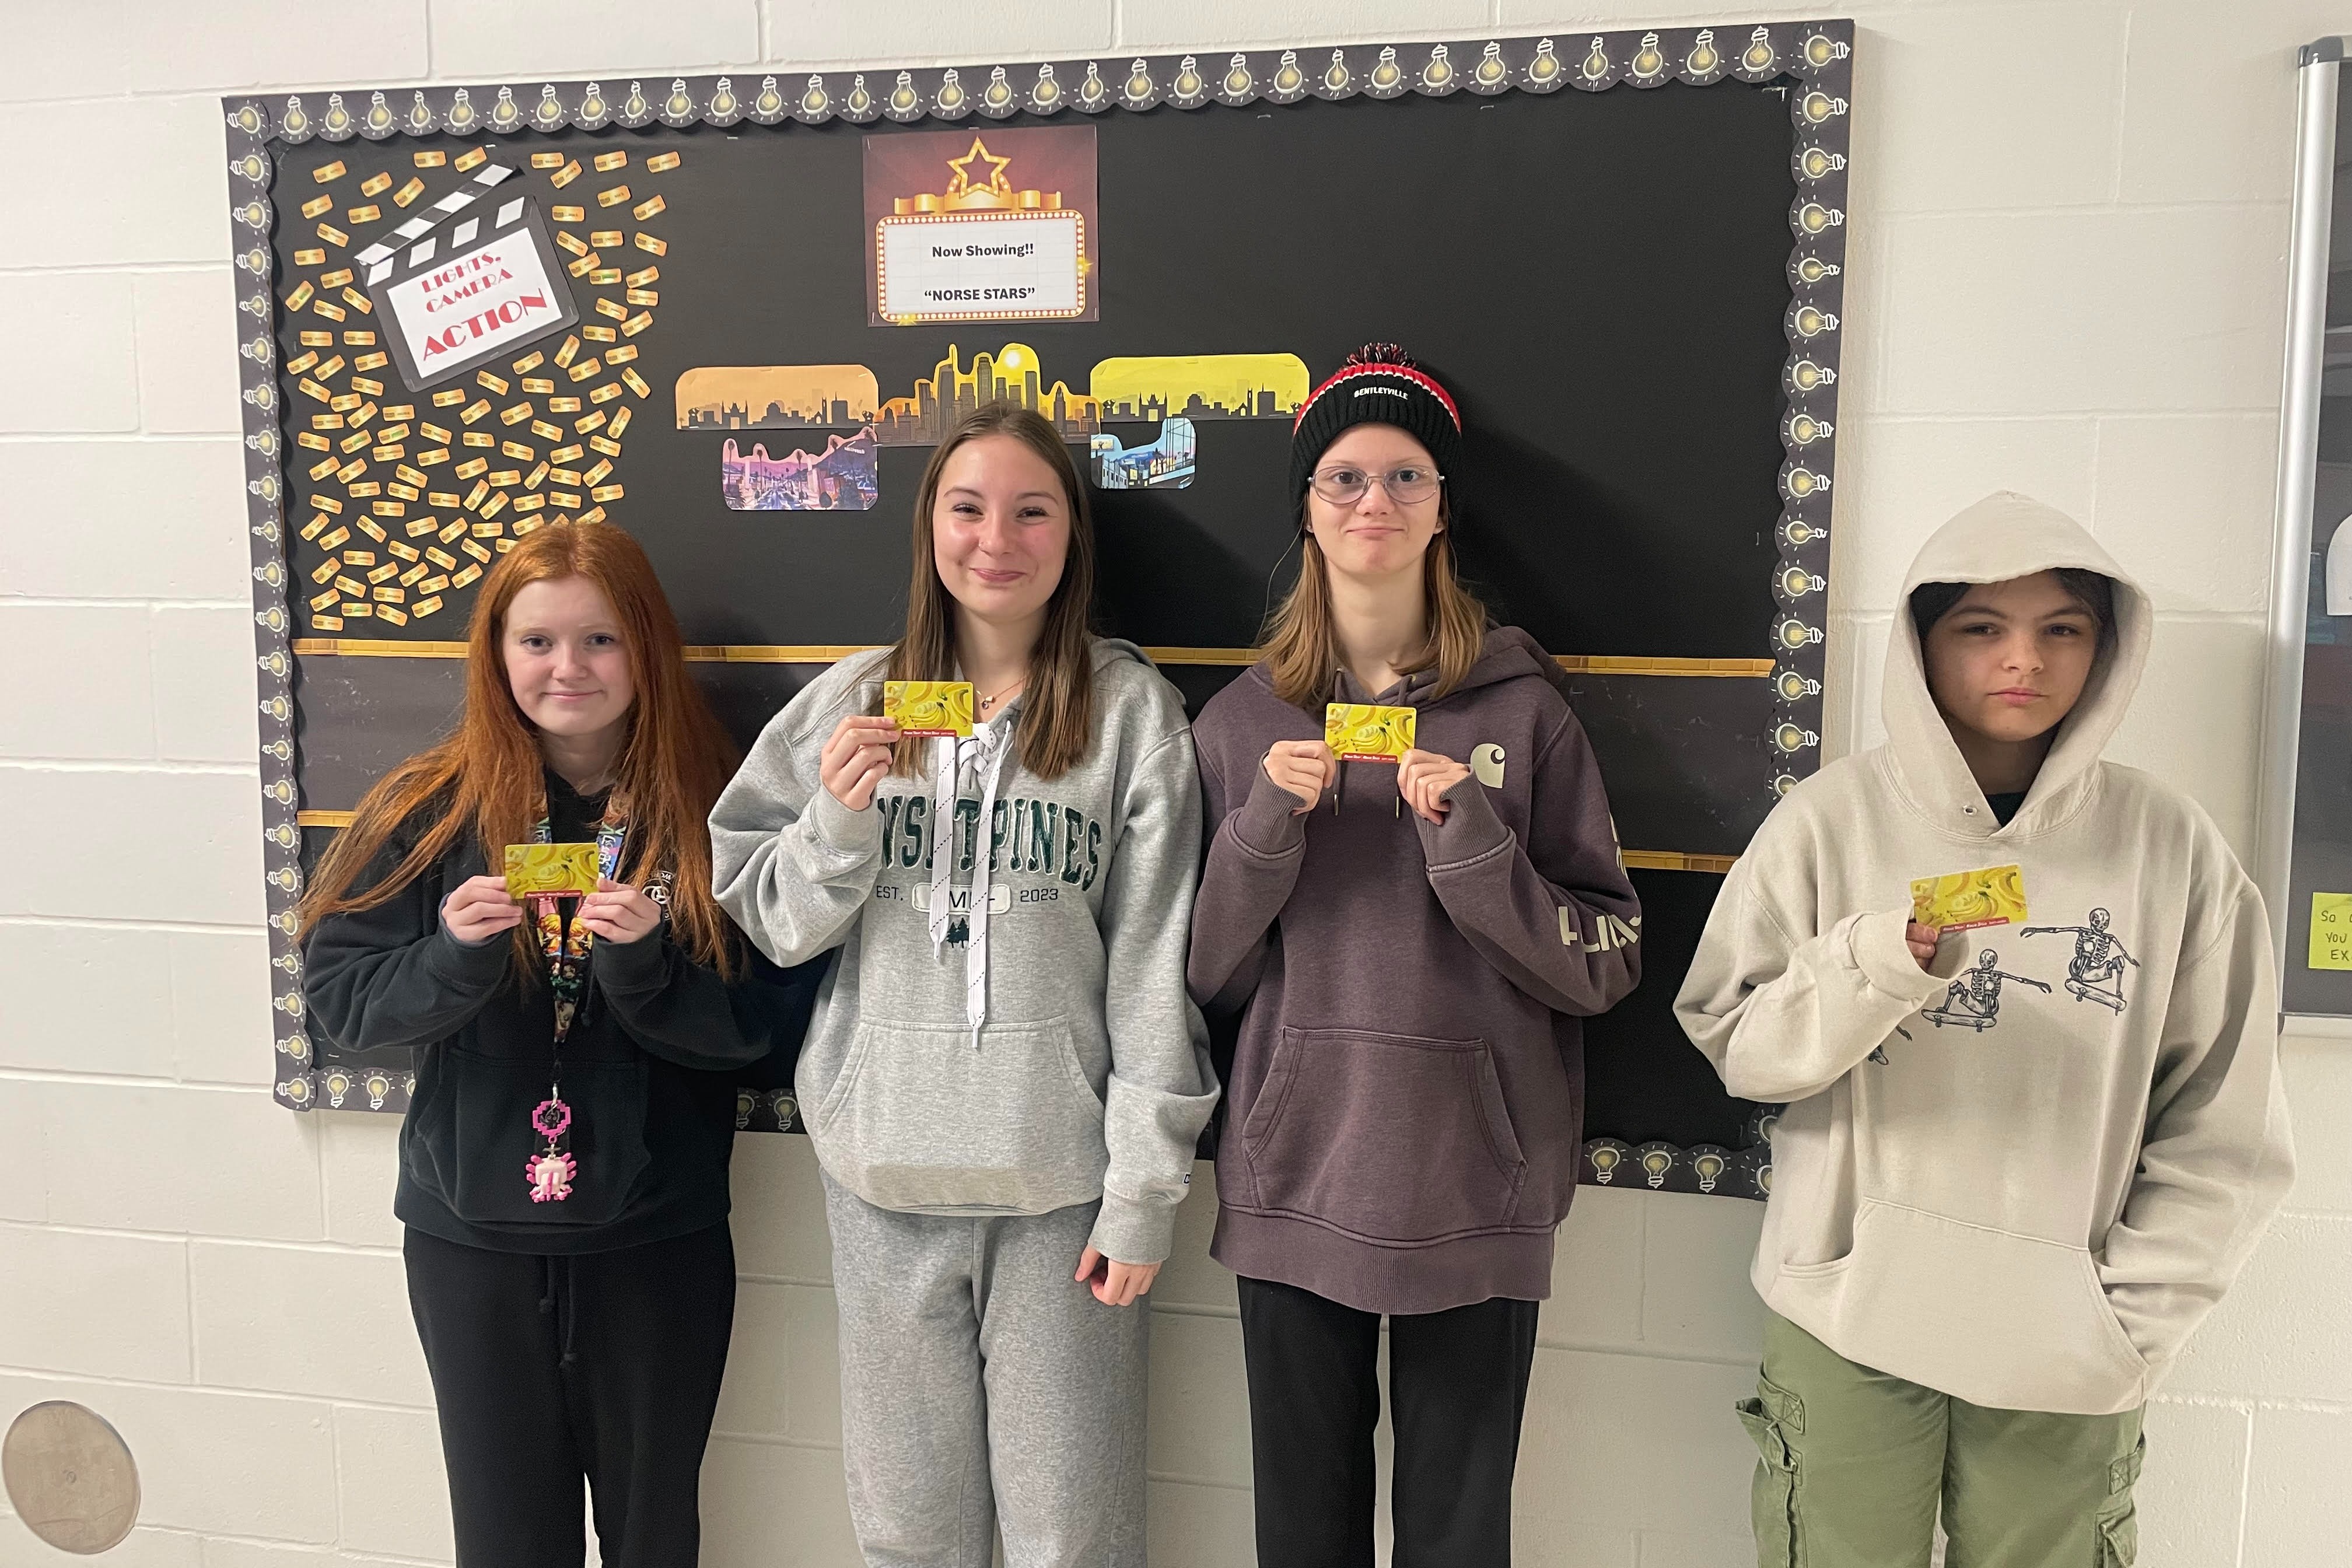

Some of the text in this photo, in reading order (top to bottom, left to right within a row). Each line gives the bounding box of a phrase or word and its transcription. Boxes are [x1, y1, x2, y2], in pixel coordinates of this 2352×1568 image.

[932, 243, 1034, 257] Now Showing!!
[426, 268, 513, 313] CAMERA
[924, 288, 1035, 301] “NORSE STARS”
[424, 288, 547, 360] ACTION
[1354, 387, 1408, 400] BENTLEYVILLE
[989, 798, 1101, 892] PINES
[876, 886, 904, 901] EST.
[1020, 888, 1059, 902] 2023
[2331, 949, 2352, 961] EX
